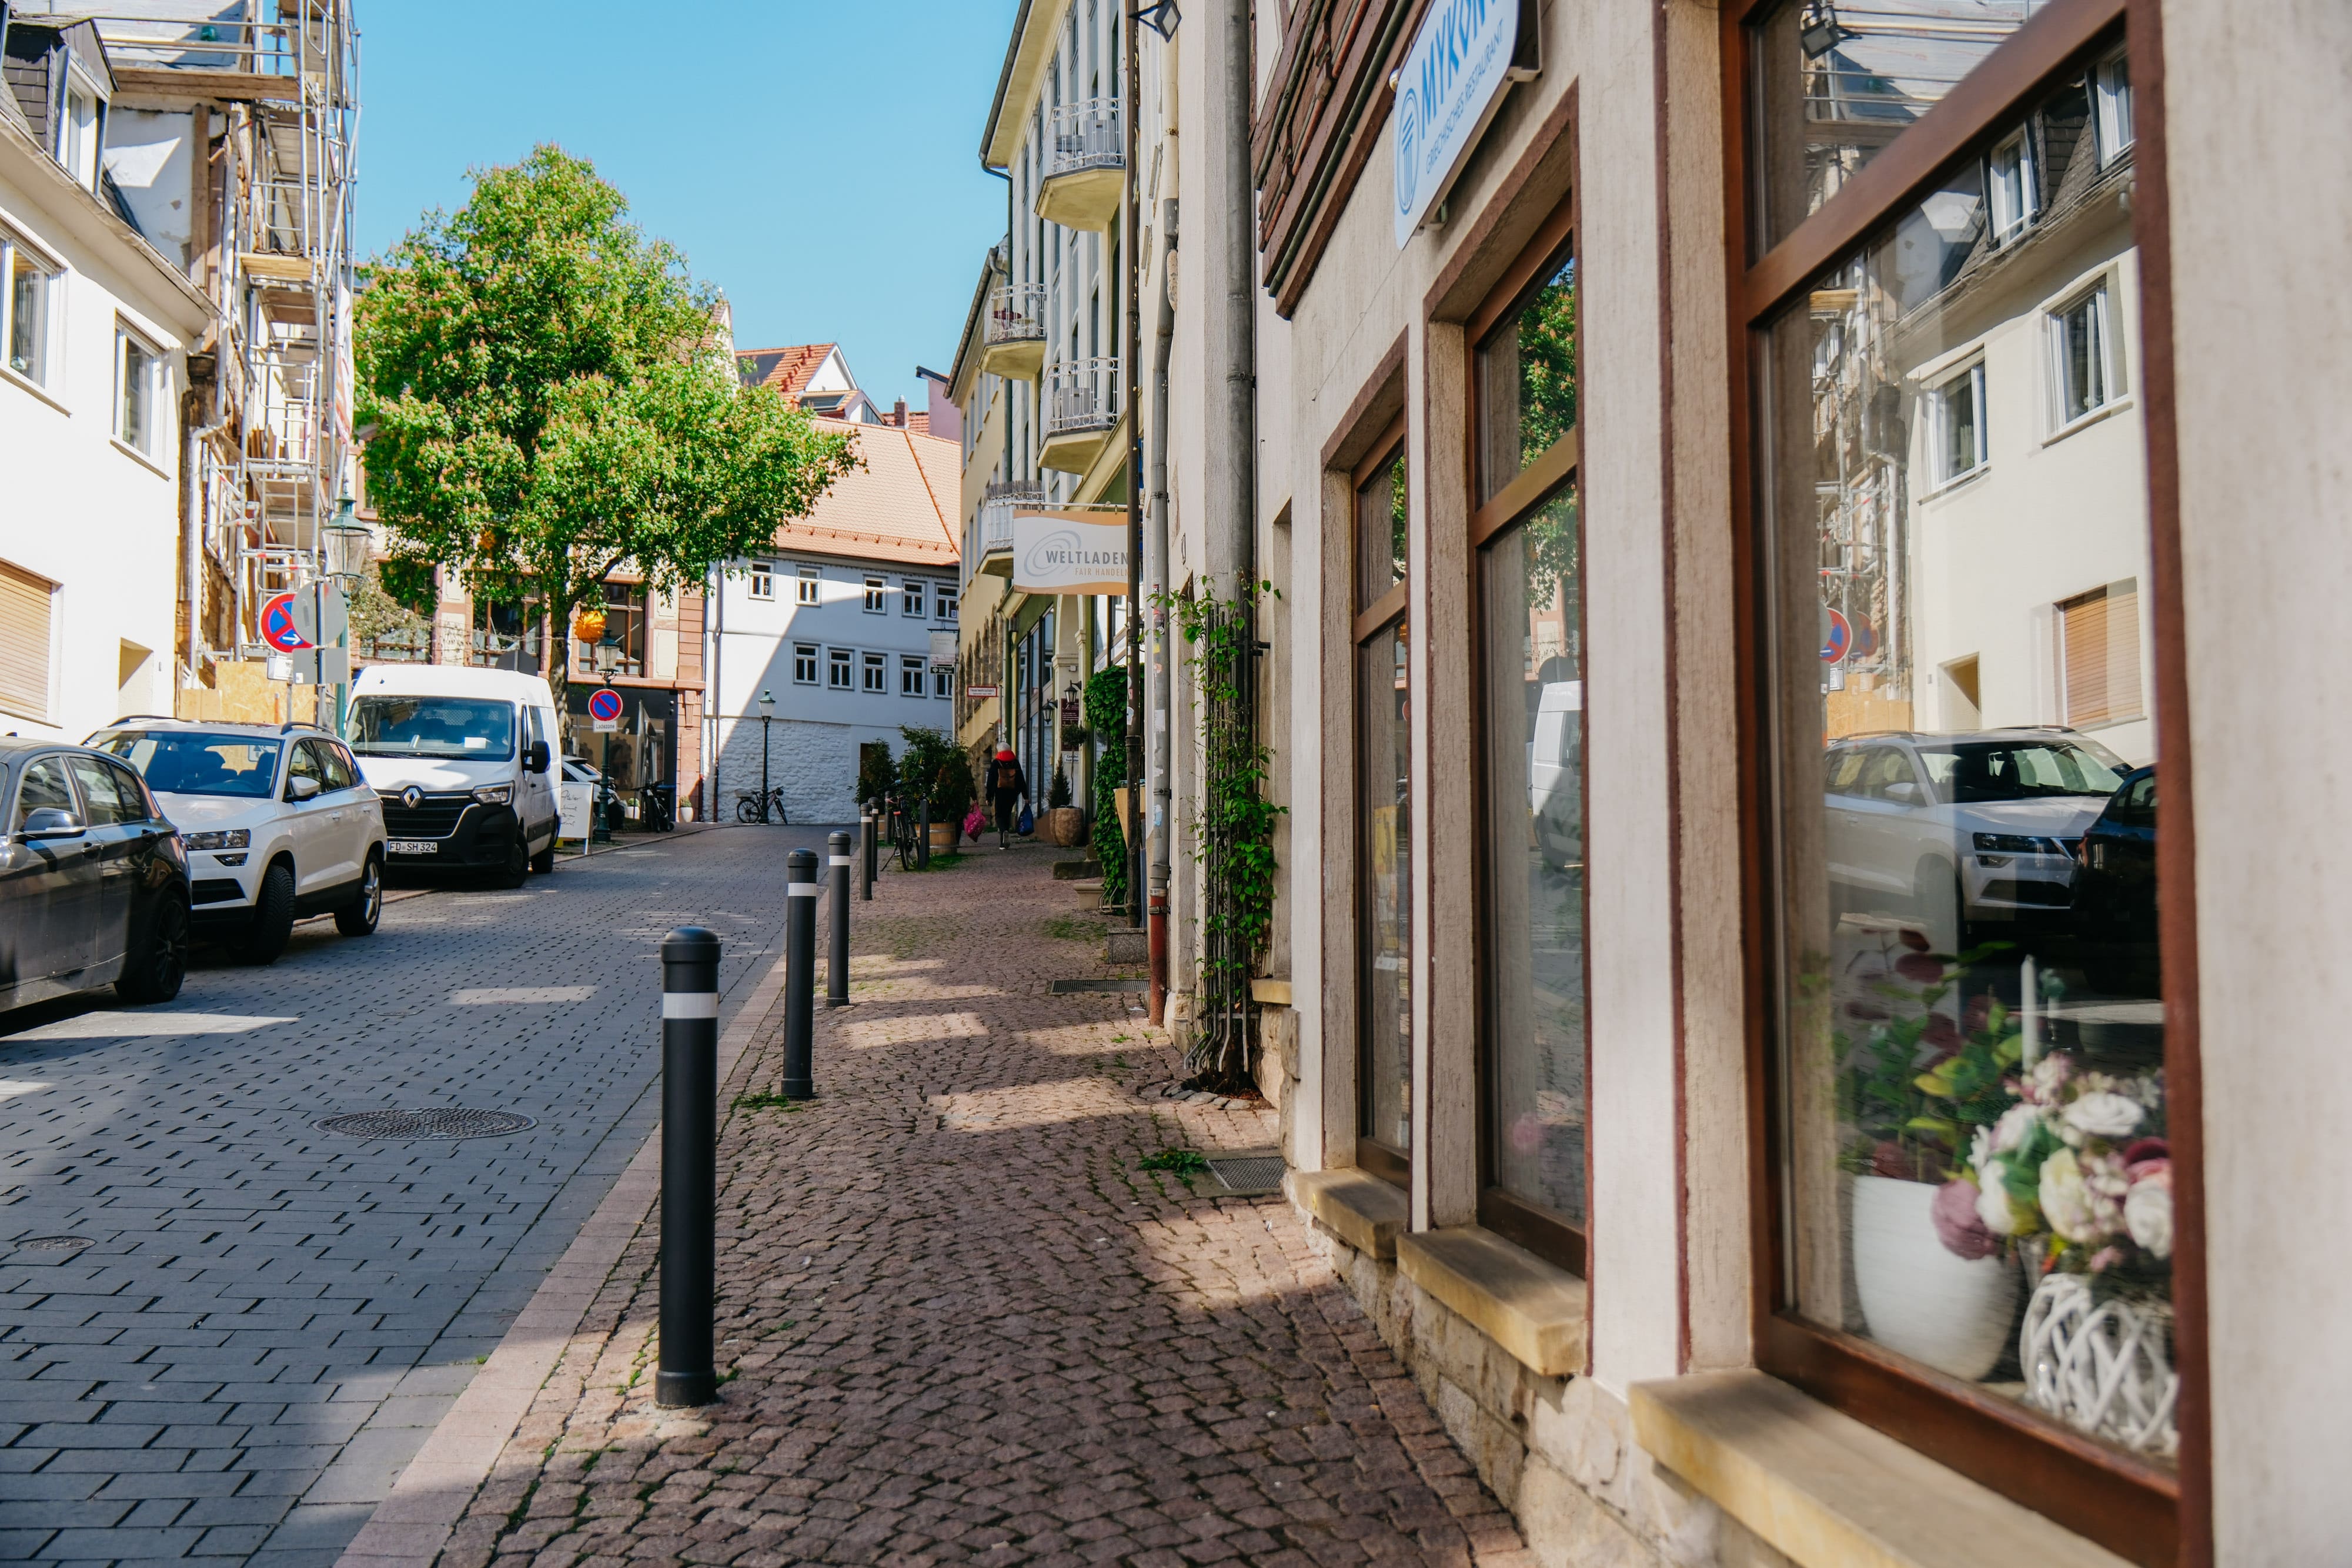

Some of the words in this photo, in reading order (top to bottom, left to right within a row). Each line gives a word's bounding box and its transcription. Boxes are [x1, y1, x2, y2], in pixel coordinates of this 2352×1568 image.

[1426, 91, 1464, 175] GRIECHISCHES
[1465, 18, 1504, 102] RESTAURANT
[1045, 550, 1128, 564] WELTLADEN
[1075, 567, 1092, 576] FAIR
[389, 842, 401, 851] FD
[407, 842, 419, 851] SH
[420, 843, 436, 851] 324
